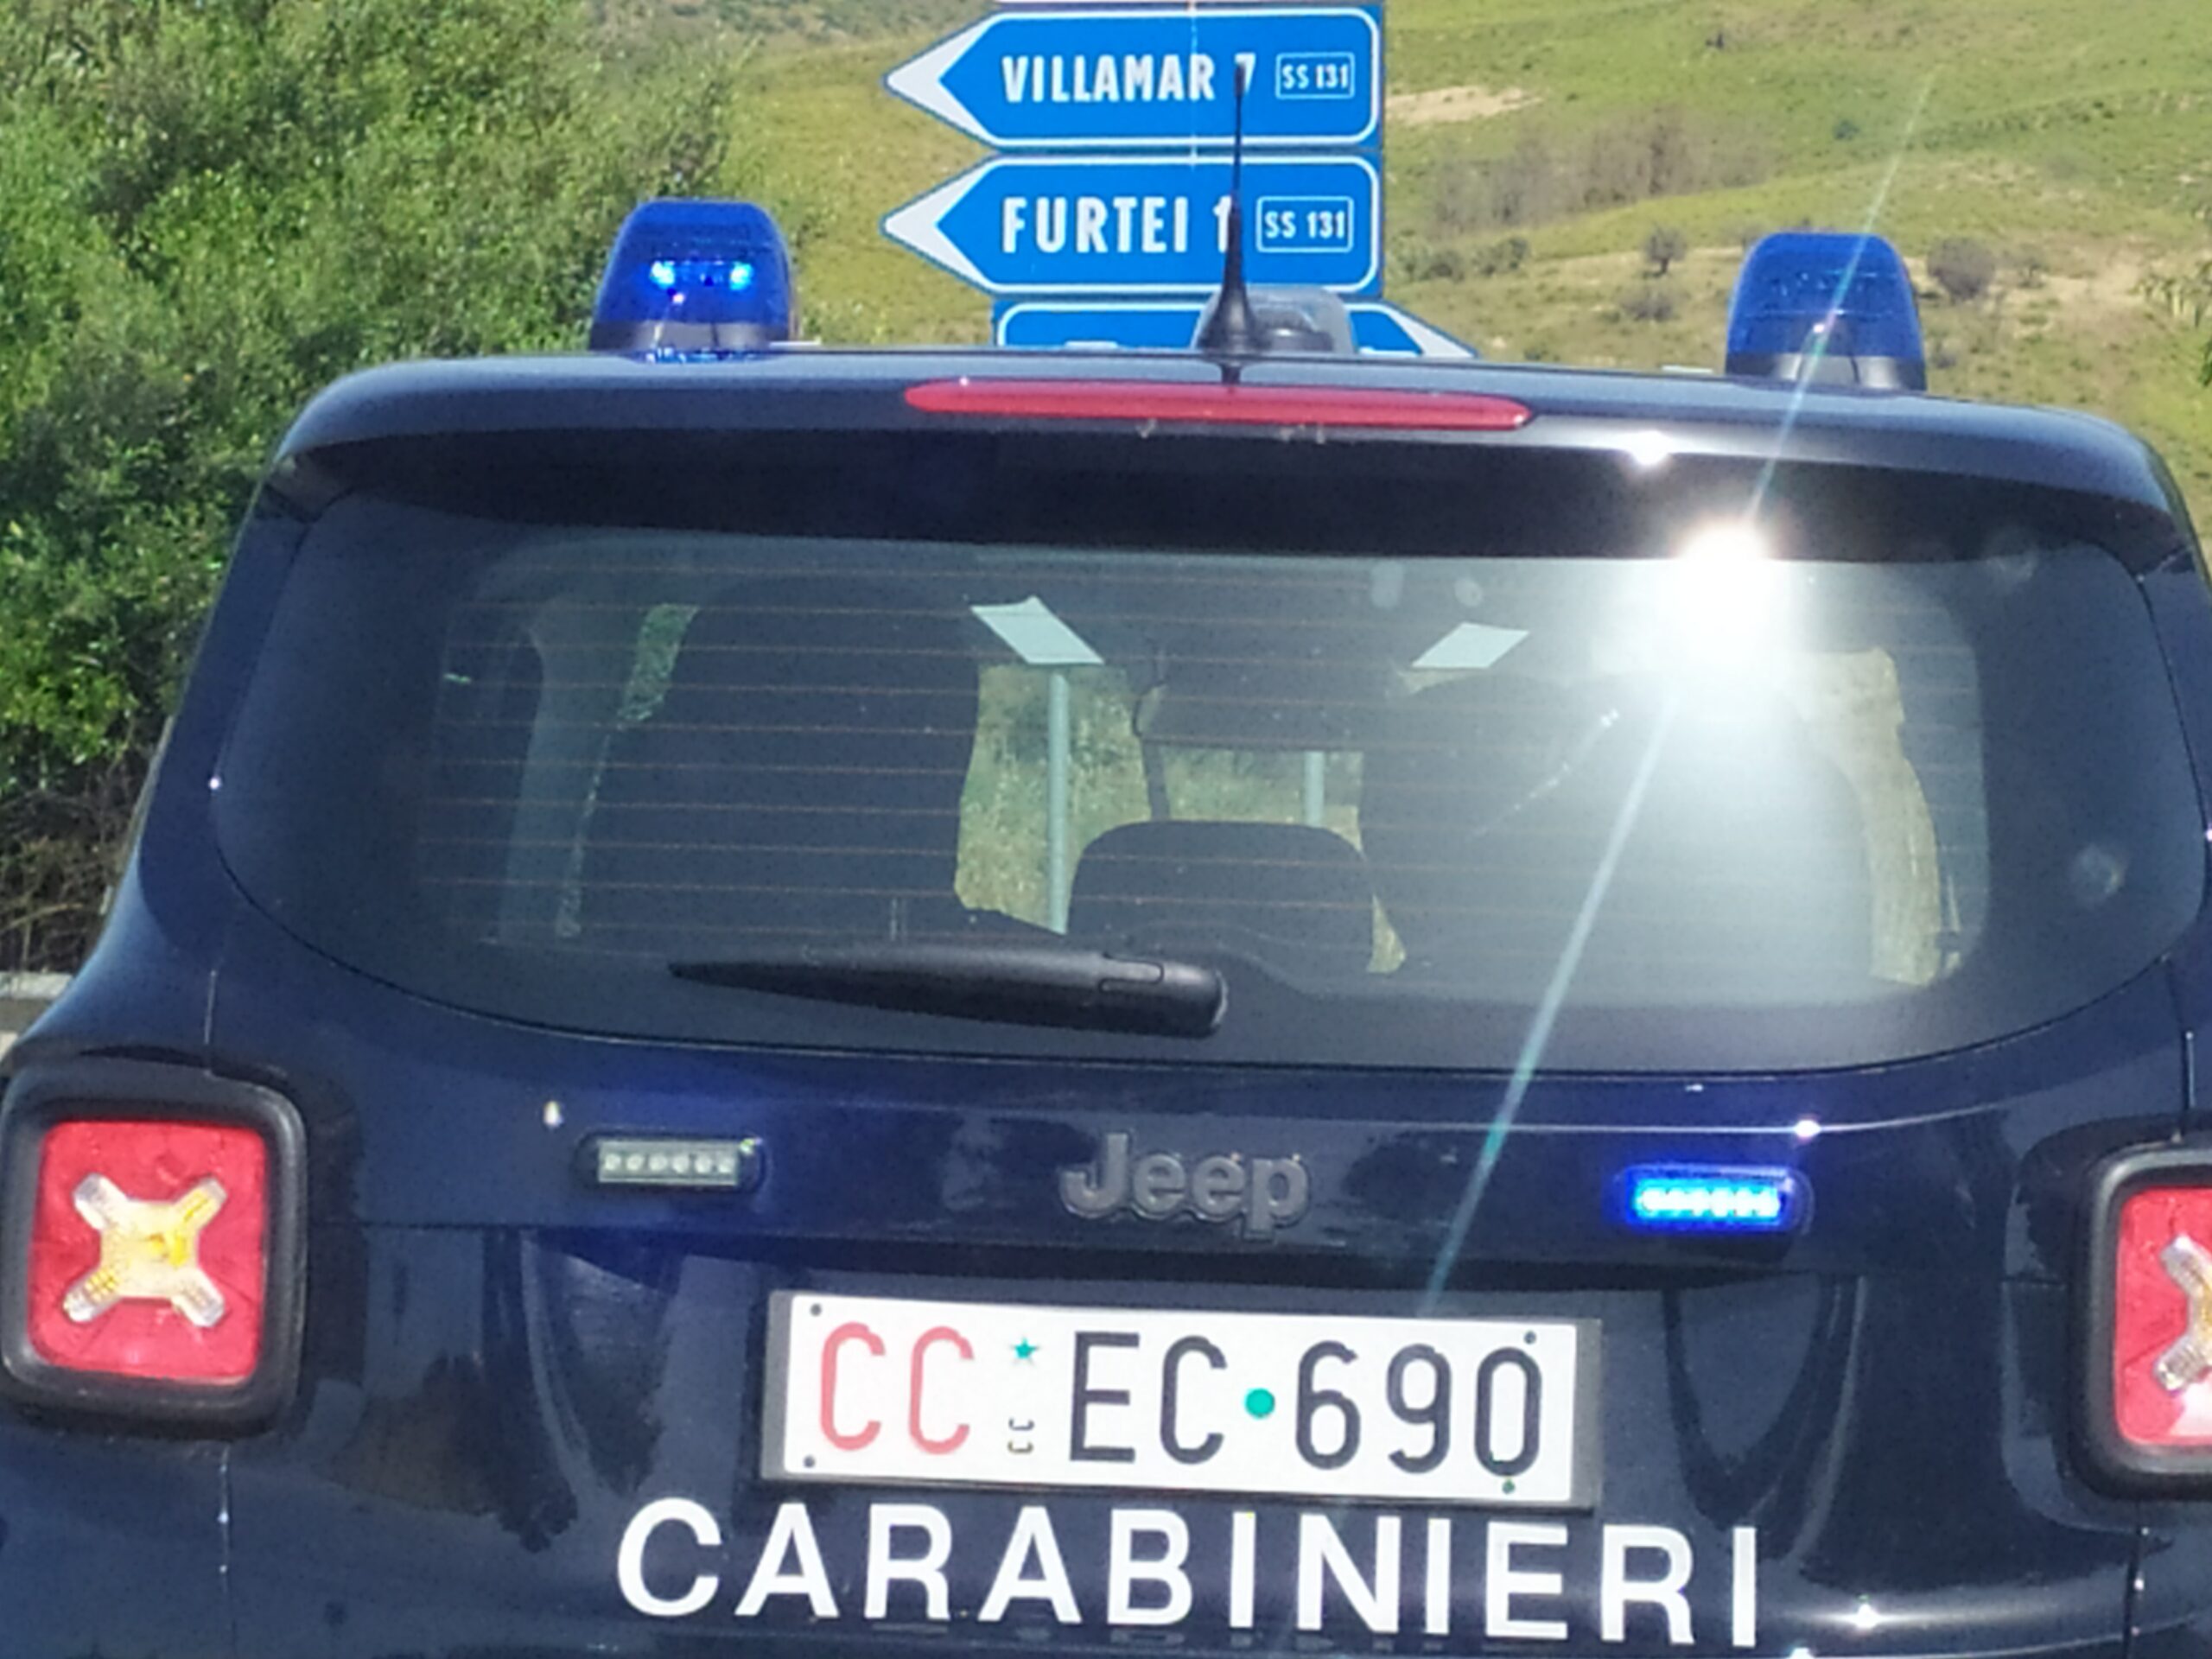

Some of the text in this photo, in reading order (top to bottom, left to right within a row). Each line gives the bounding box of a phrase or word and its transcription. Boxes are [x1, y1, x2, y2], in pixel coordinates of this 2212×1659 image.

[1002, 52, 1349, 103] VILLAMAR 7 SS 131
[1002, 196, 1188, 253] FURTEI
[1264, 211, 1296, 238] SS
[1306, 210, 1345, 238] 131
[1059, 1132, 1310, 1242] Jeep
[818, 1321, 1544, 1478] CC EC 690
[616, 1497, 1758, 1648] CARABINIERI
